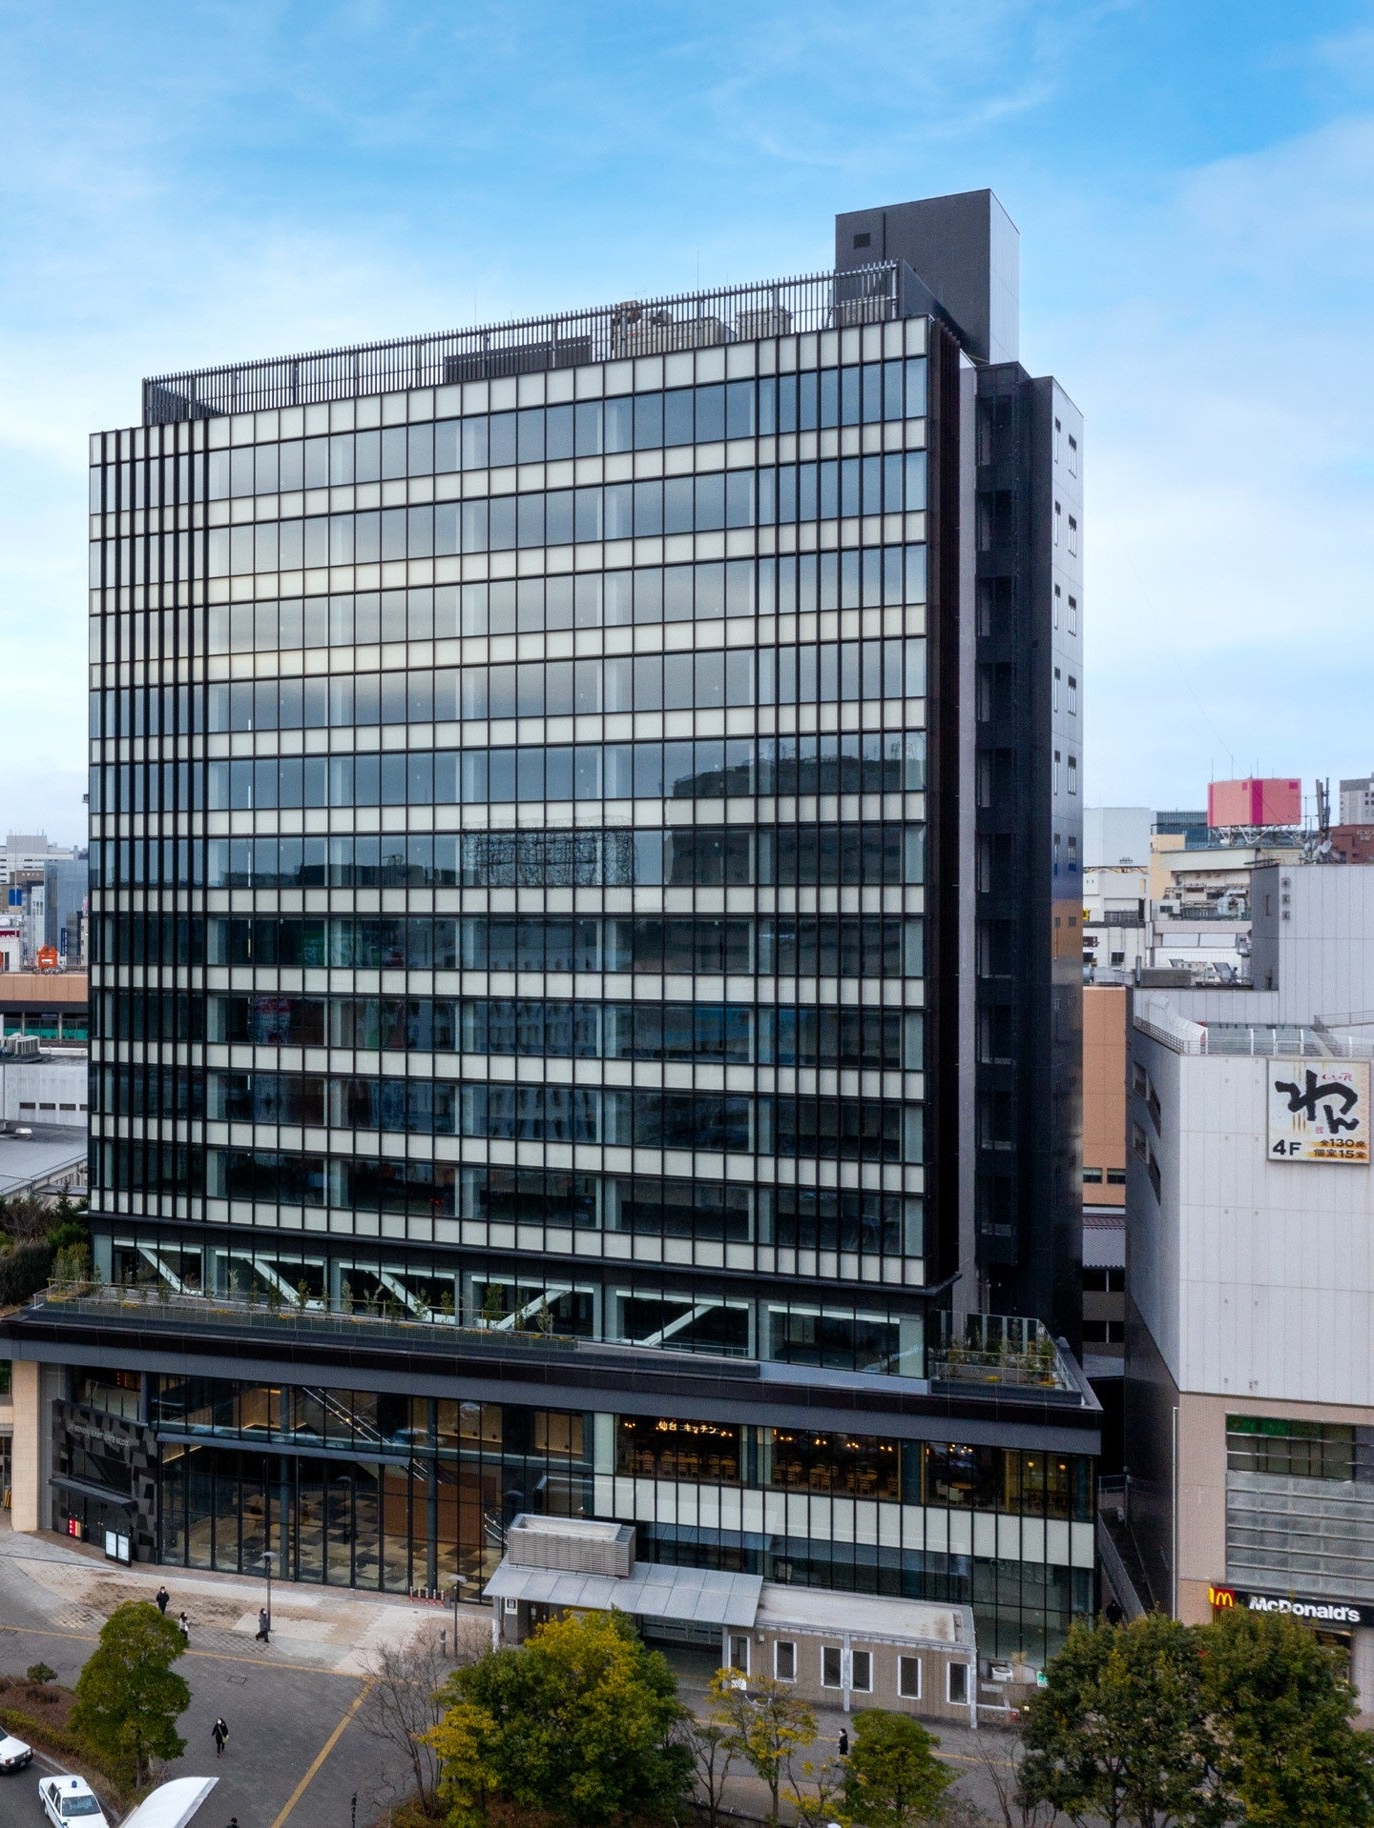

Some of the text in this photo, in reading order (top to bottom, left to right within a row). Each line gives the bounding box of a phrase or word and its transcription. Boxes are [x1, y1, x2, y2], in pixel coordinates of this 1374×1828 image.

[1275, 1069, 1359, 1134] わん
[1273, 1139, 1302, 1156] 4F
[1248, 1596, 1361, 1622] McDonald's
